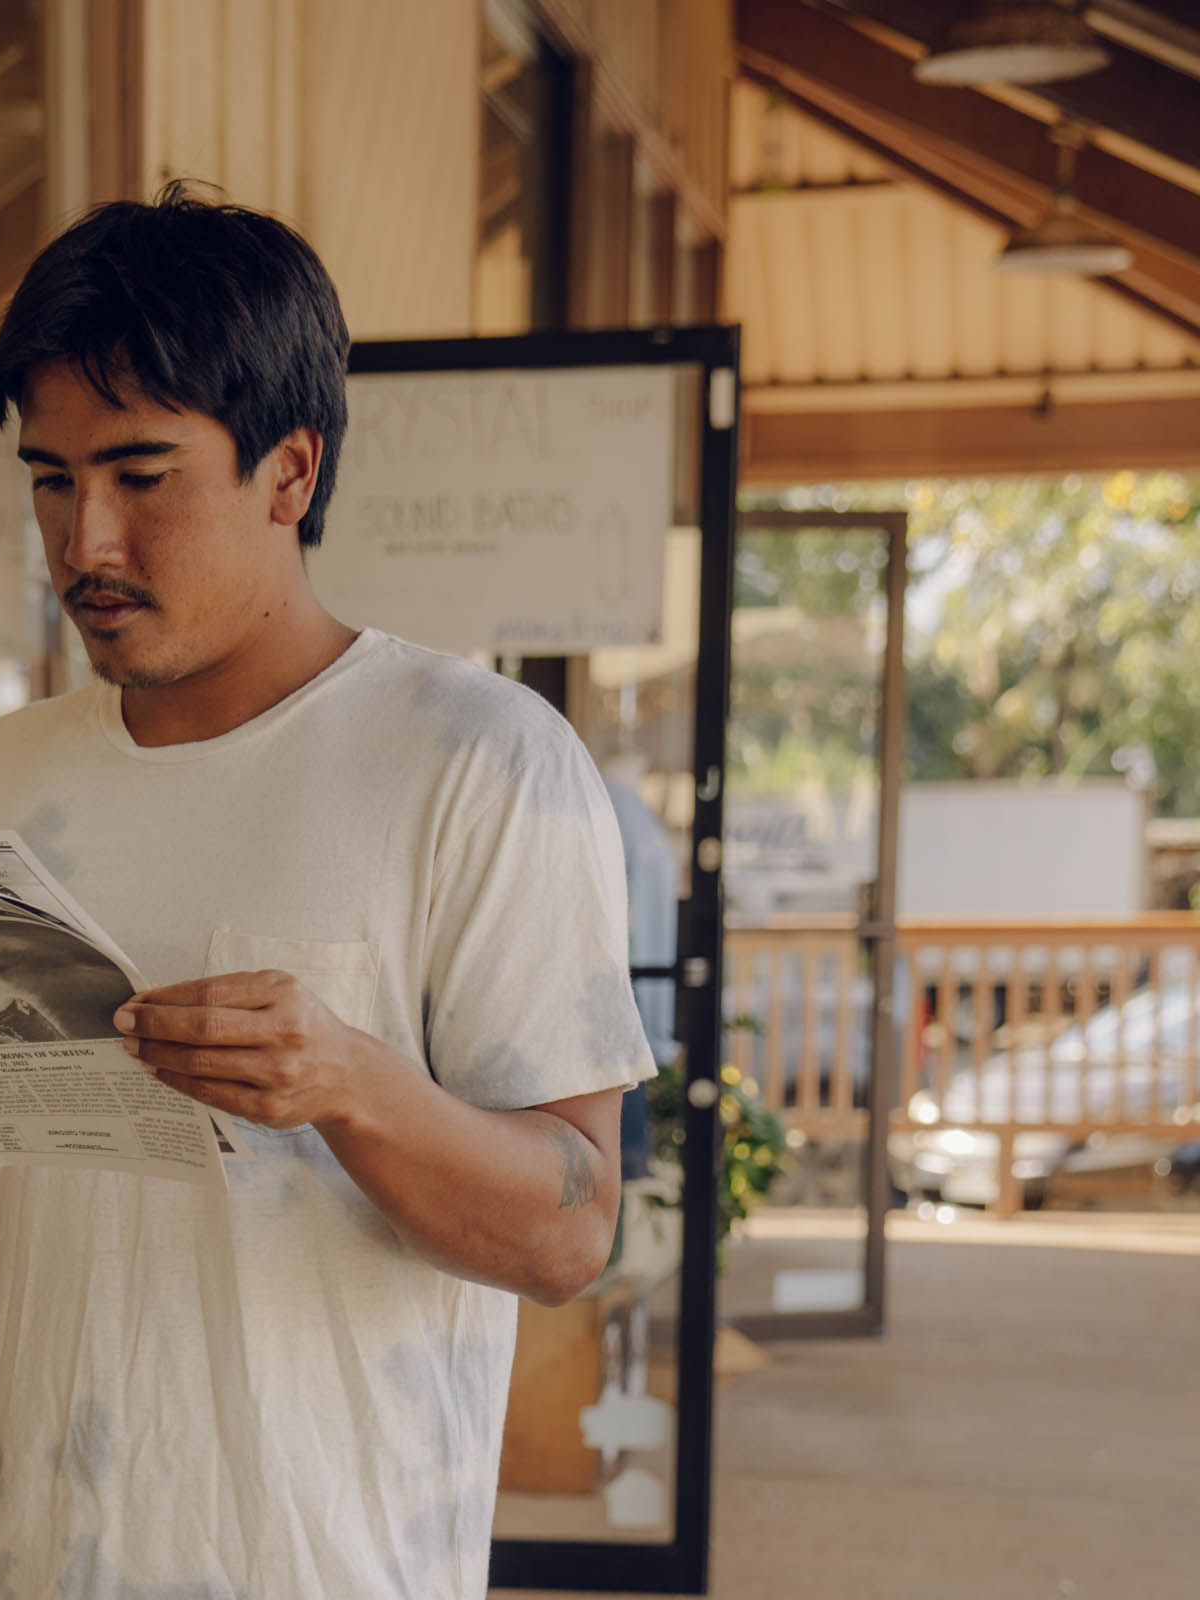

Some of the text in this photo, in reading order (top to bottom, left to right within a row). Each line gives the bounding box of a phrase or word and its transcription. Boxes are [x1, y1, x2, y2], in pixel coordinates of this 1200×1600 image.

[354, 381, 556, 467] RYSTAL
[34, 1051, 47, 1059] OF
[48, 1049, 95, 1058] SURFING
